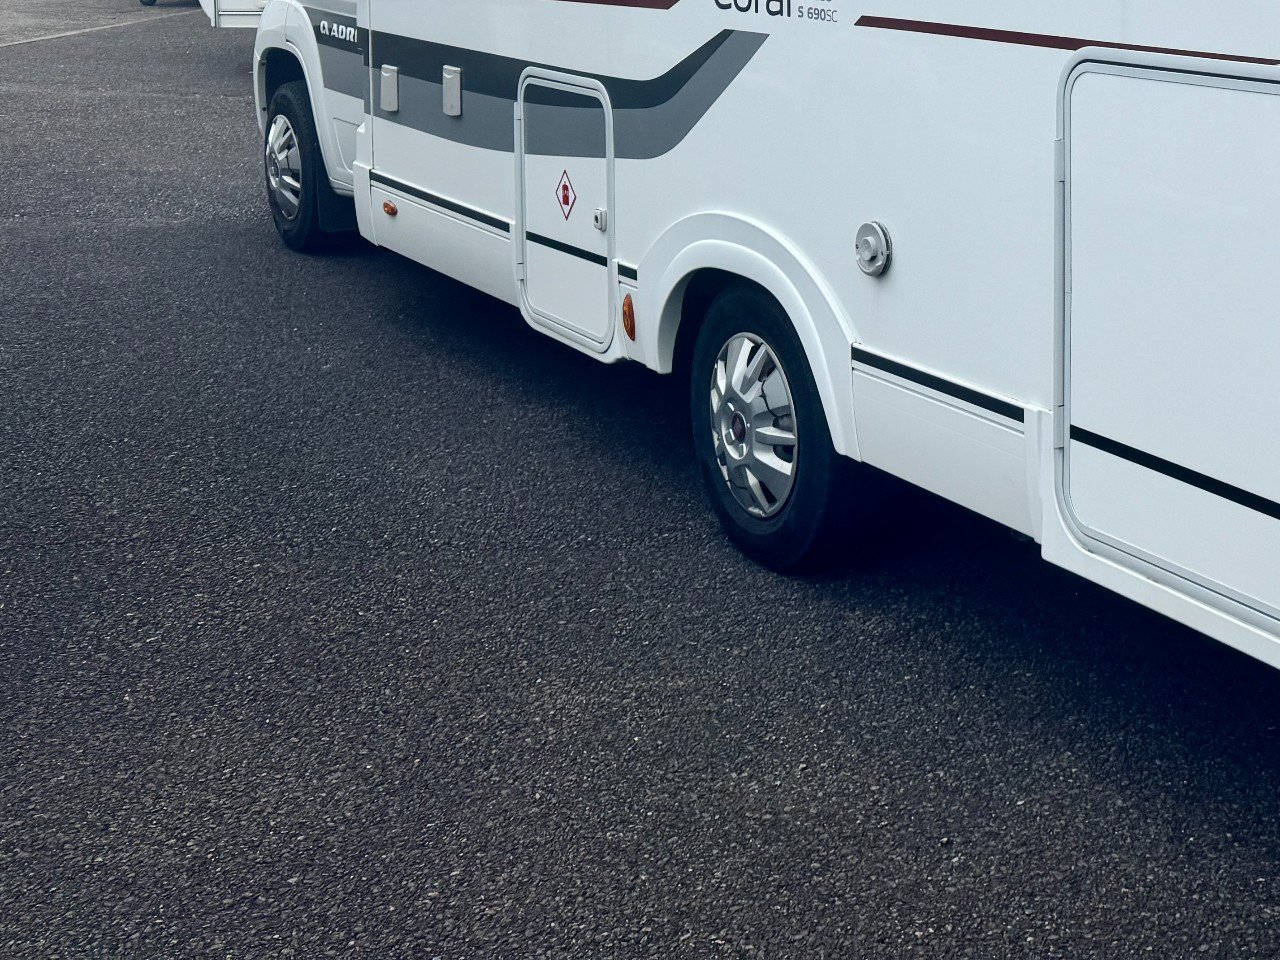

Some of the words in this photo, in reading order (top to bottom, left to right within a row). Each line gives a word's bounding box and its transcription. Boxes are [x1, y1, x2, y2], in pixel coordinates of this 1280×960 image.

[797, 5, 804, 18] S
[807, 6, 838, 23] 690SC
[331, 23, 358, 43] ADRI
